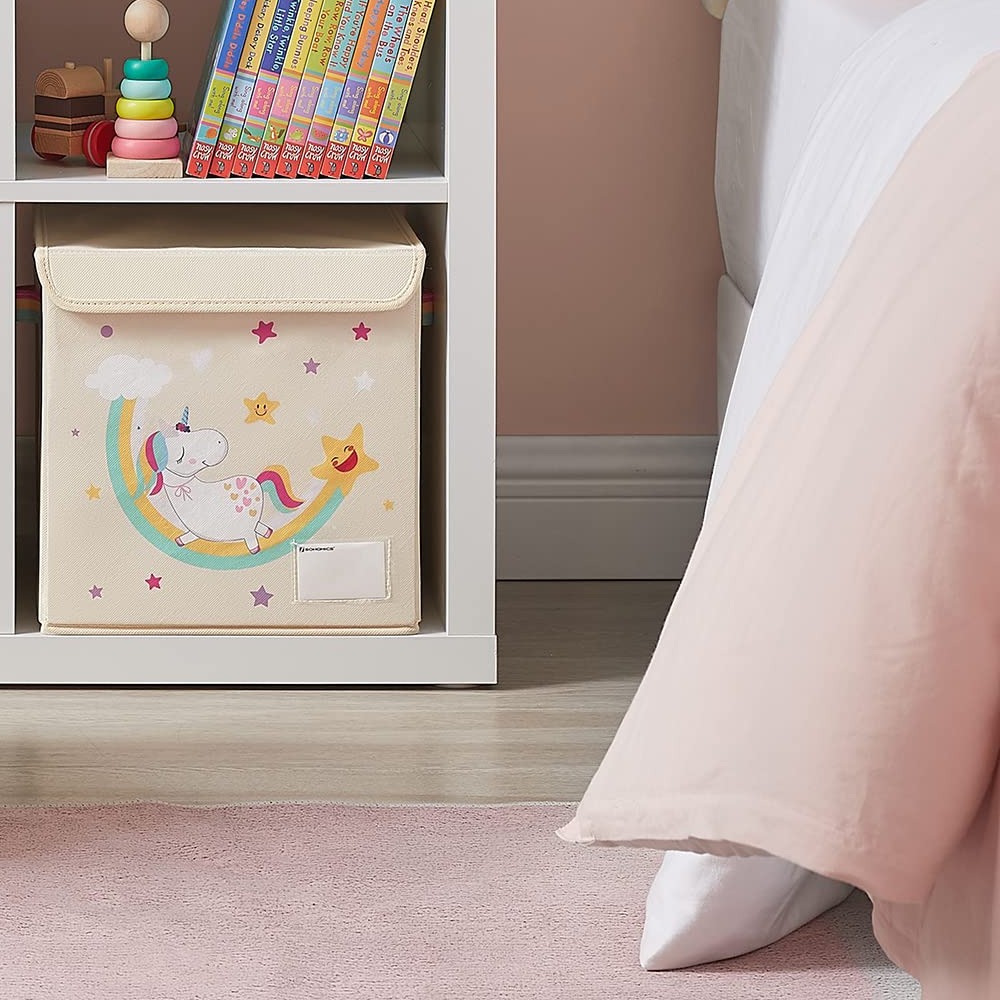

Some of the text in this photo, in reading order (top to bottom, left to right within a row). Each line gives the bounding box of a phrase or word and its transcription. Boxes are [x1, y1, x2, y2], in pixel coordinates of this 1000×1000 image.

[232, 13, 246, 41] Diddle
[249, 22, 264, 50] Dickory
[266, 8, 285, 55] Little Star
[312, 8, 330, 53] Your Boat
[340, 14, 350, 31] You
[350, 9, 364, 37] You're
[376, 4, 395, 58] on the Bus
[385, 4, 408, 64] The Wheels
[398, 1, 421, 67] Knees and Toes
[224, 42, 237, 69] Diddle
[246, 51, 256, 69] Dock
[271, 34, 289, 73] Twinkle,
[291, 34, 307, 70] Bunnies
[320, 46, 331, 66] Row
[332, 33, 345, 58] Know
[339, 38, 355, 69] Happy
[357, 29, 376, 69] Birthday
